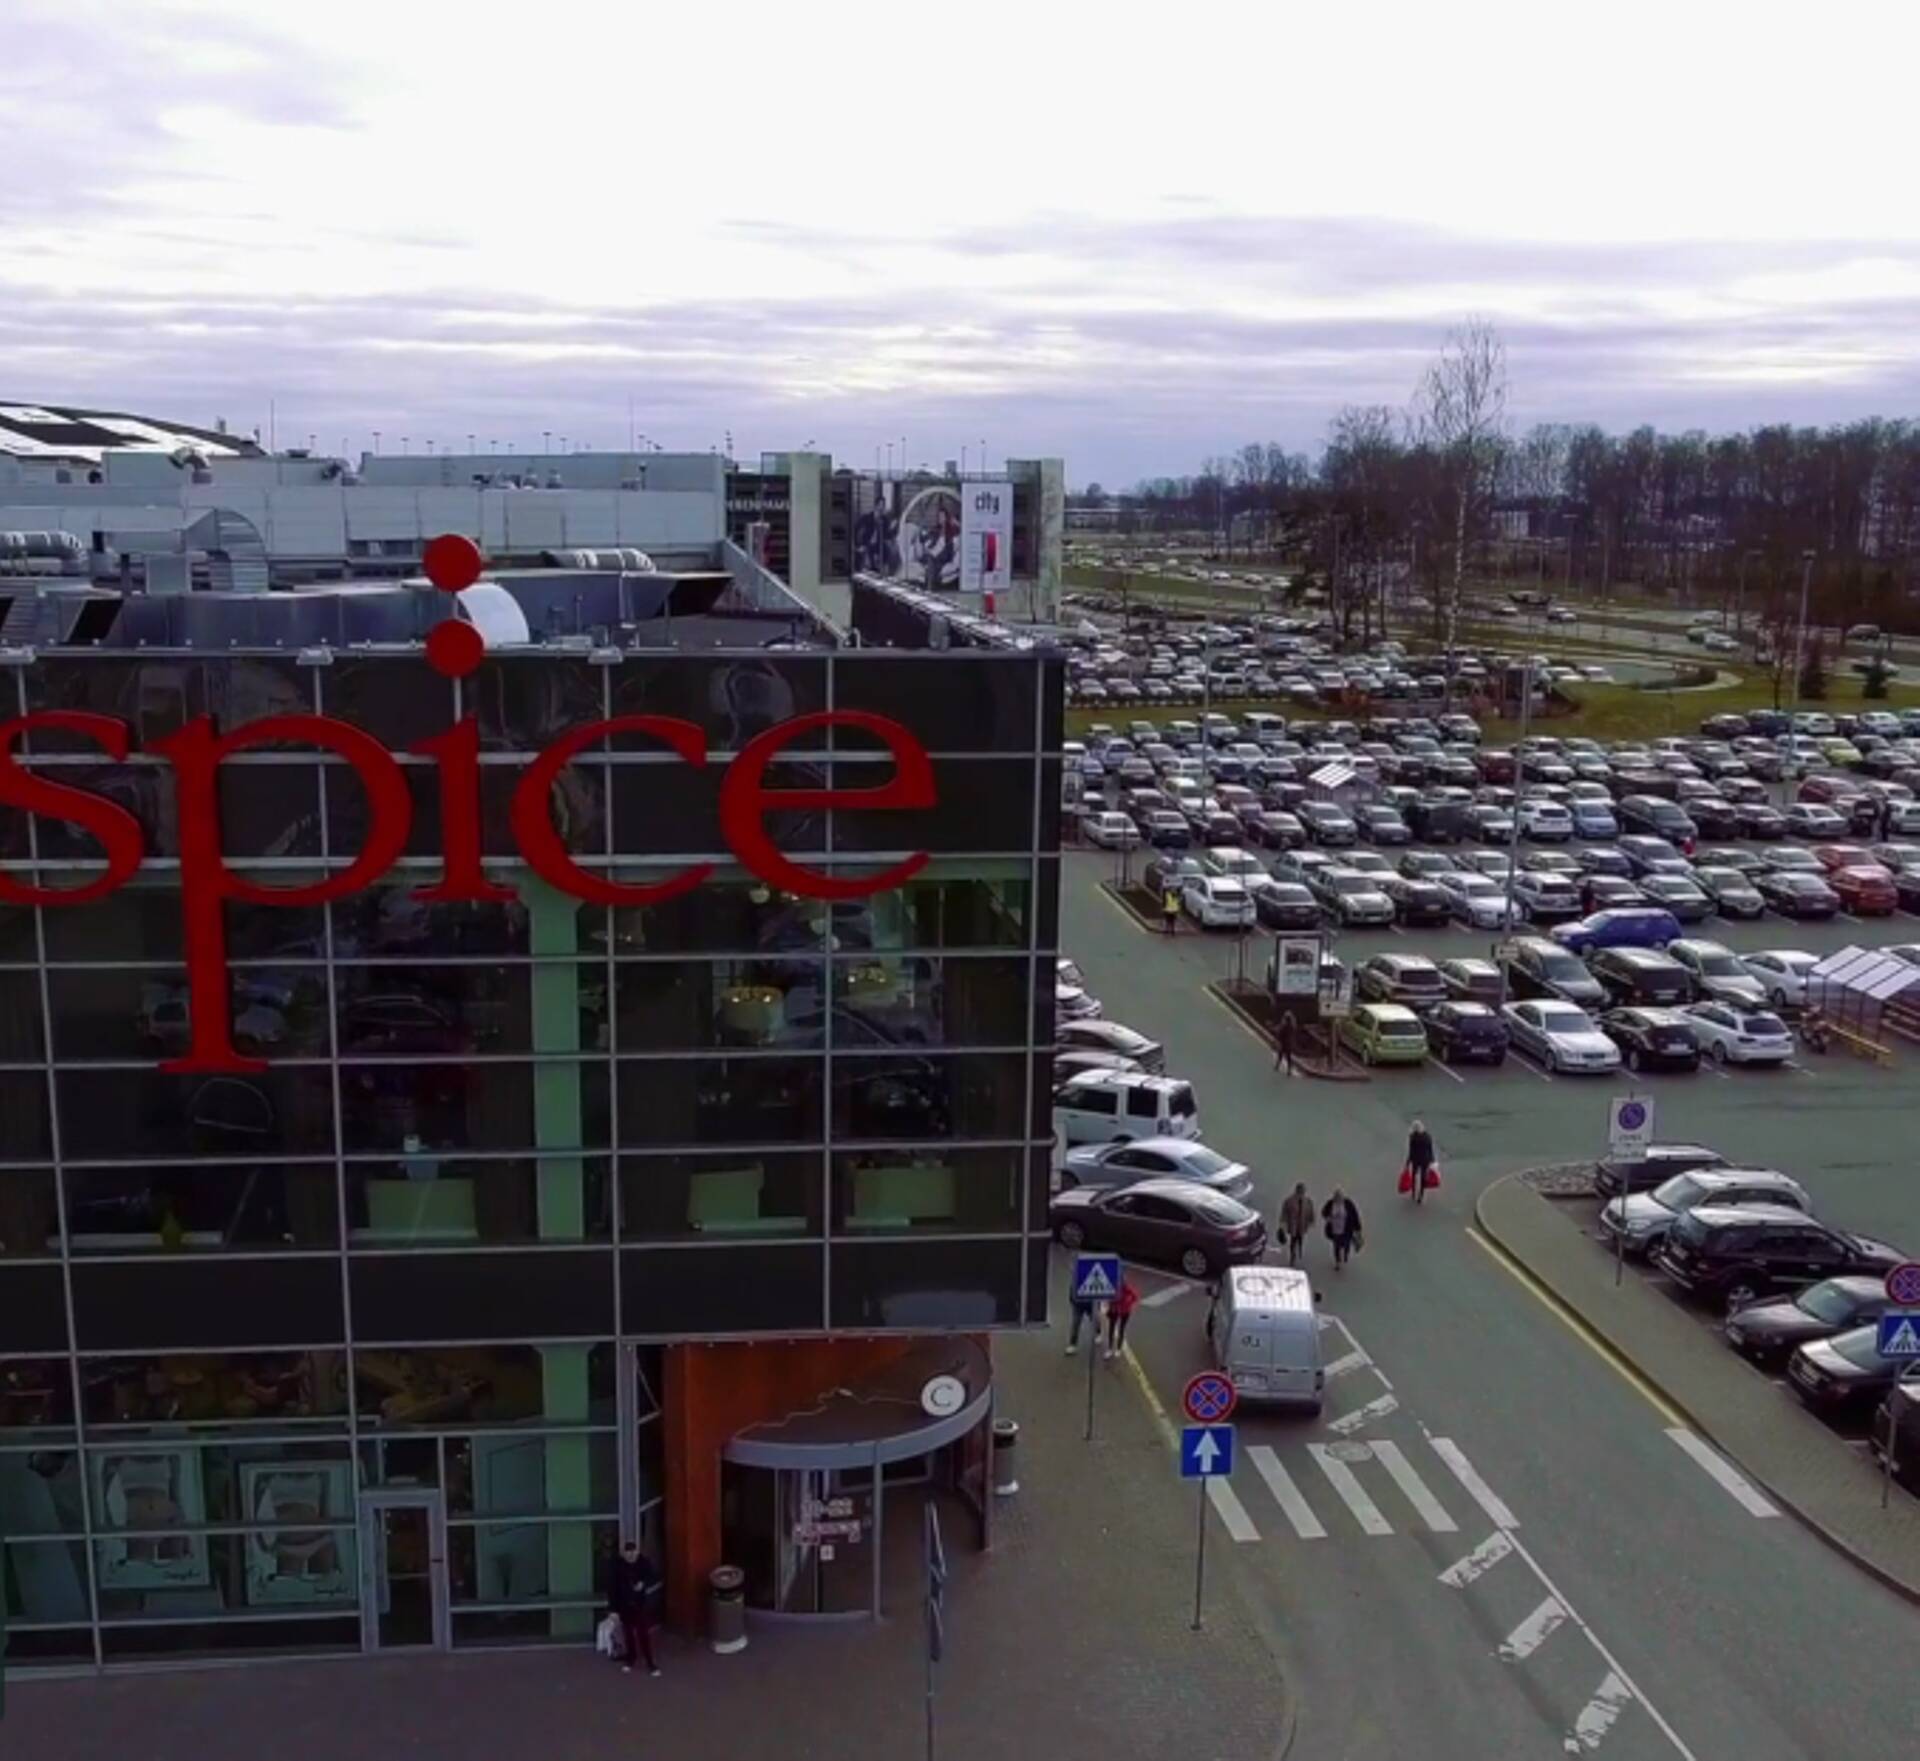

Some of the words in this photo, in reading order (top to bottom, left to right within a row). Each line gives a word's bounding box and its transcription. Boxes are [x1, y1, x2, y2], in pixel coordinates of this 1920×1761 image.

[975, 491, 999, 515] city
[0, 536, 937, 1073] spice
[930, 1384, 953, 1408] C
